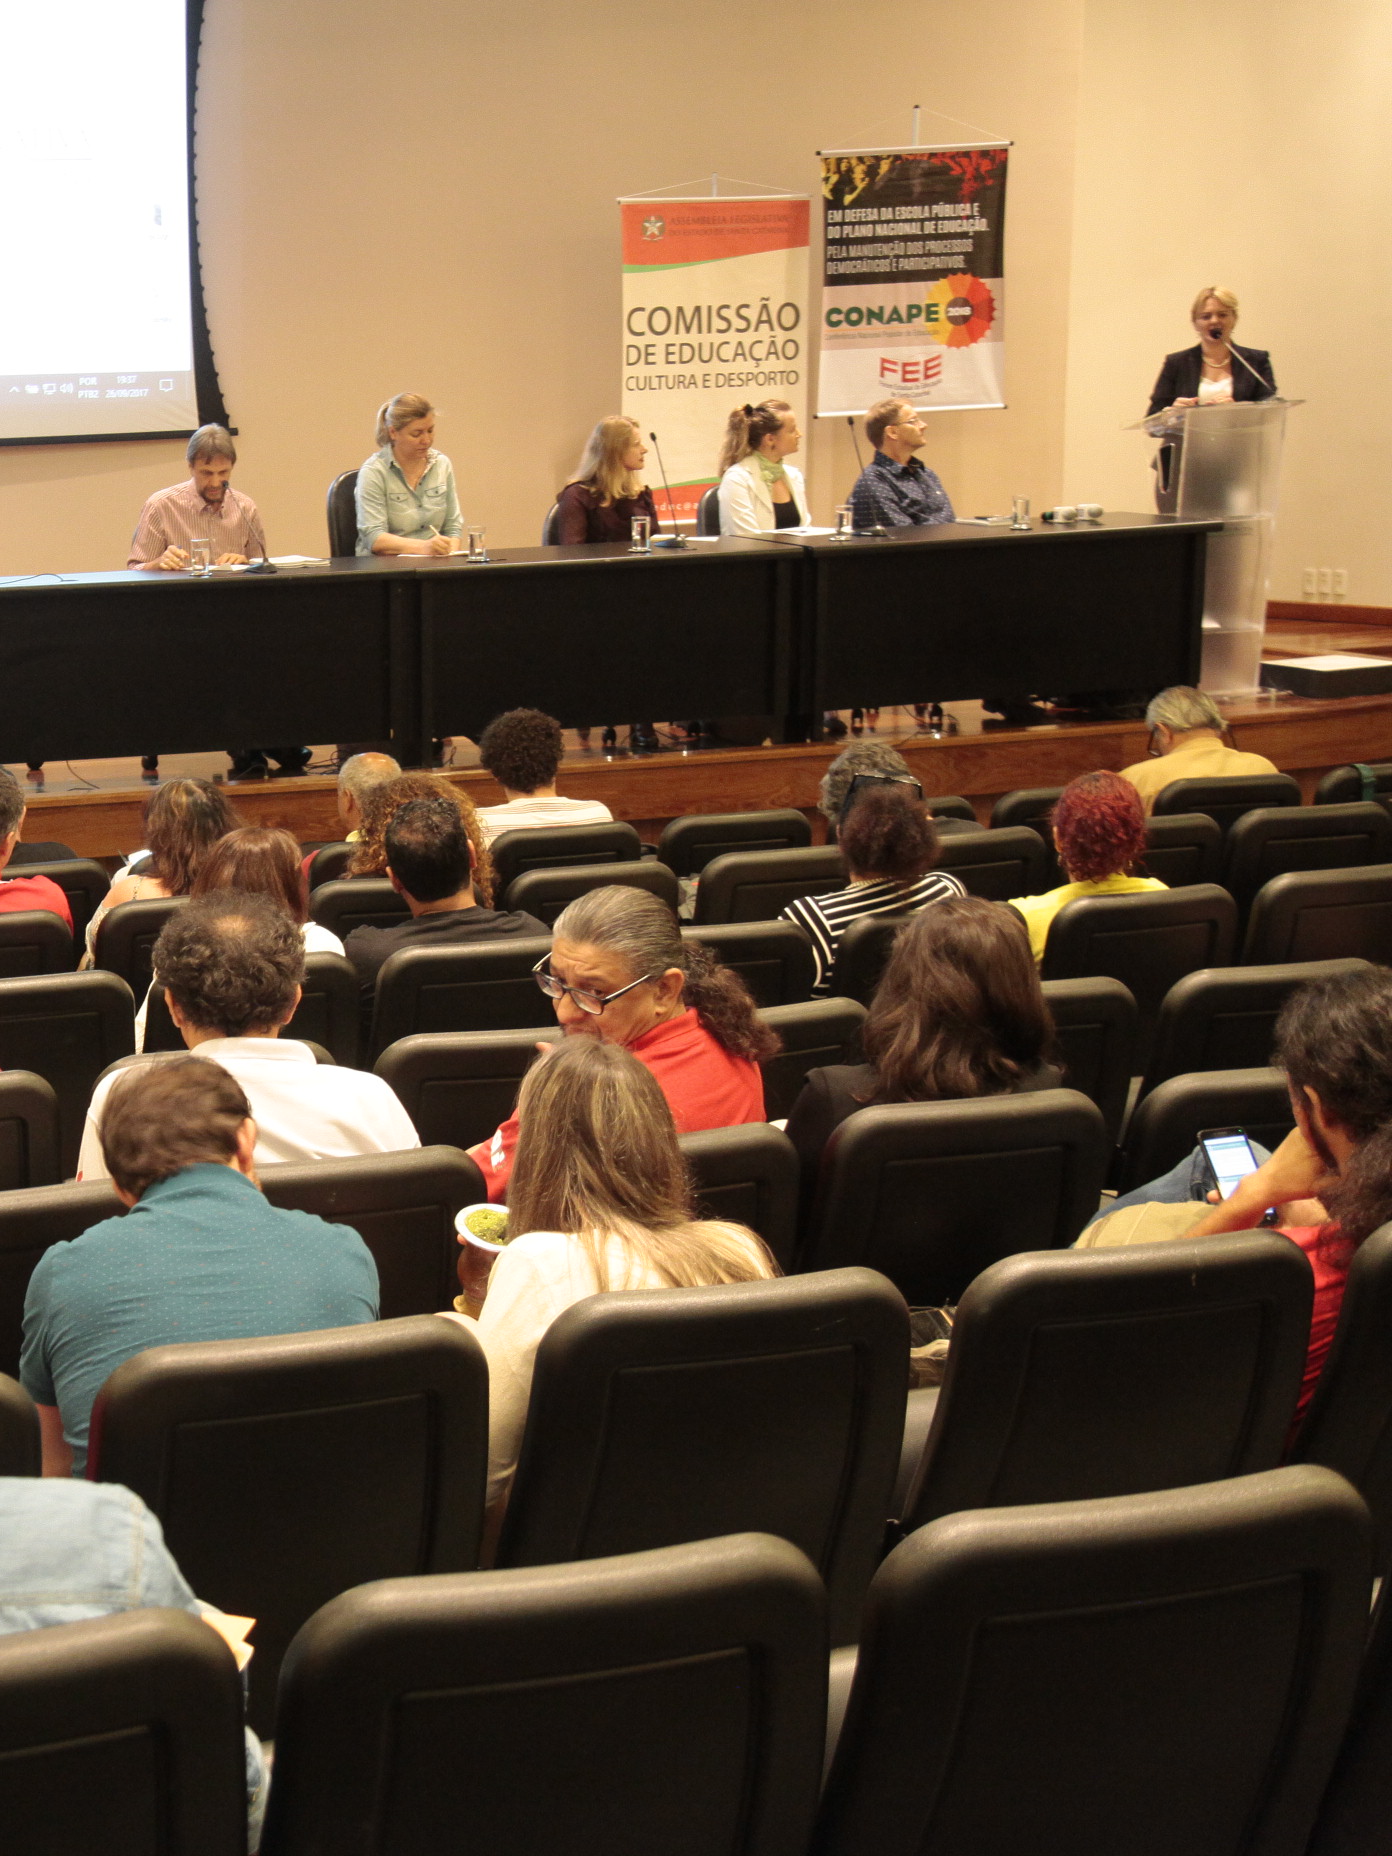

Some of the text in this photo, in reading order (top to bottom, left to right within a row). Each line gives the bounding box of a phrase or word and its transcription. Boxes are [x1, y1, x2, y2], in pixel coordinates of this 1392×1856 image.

[828, 202, 980, 222] EM DEFESA DA ESCOLA PÚBLICA E
[827, 225, 841, 238] DO
[842, 224, 874, 237] PLANO
[875, 221, 922, 236] NACIONAL
[923, 221, 937, 234] DE
[827, 245, 848, 258] PELA
[907, 242, 924, 255] DOS
[925, 239, 974, 253] PROCESSOS
[892, 258, 898, 271] E
[626, 297, 800, 336] COMISSÃO
[825, 303, 939, 327] CONAPE
[626, 335, 799, 368] DE EDUCAÇÃO
[879, 353, 942, 383] FEE
[626, 370, 799, 391] CULTURA E DESPORTO
